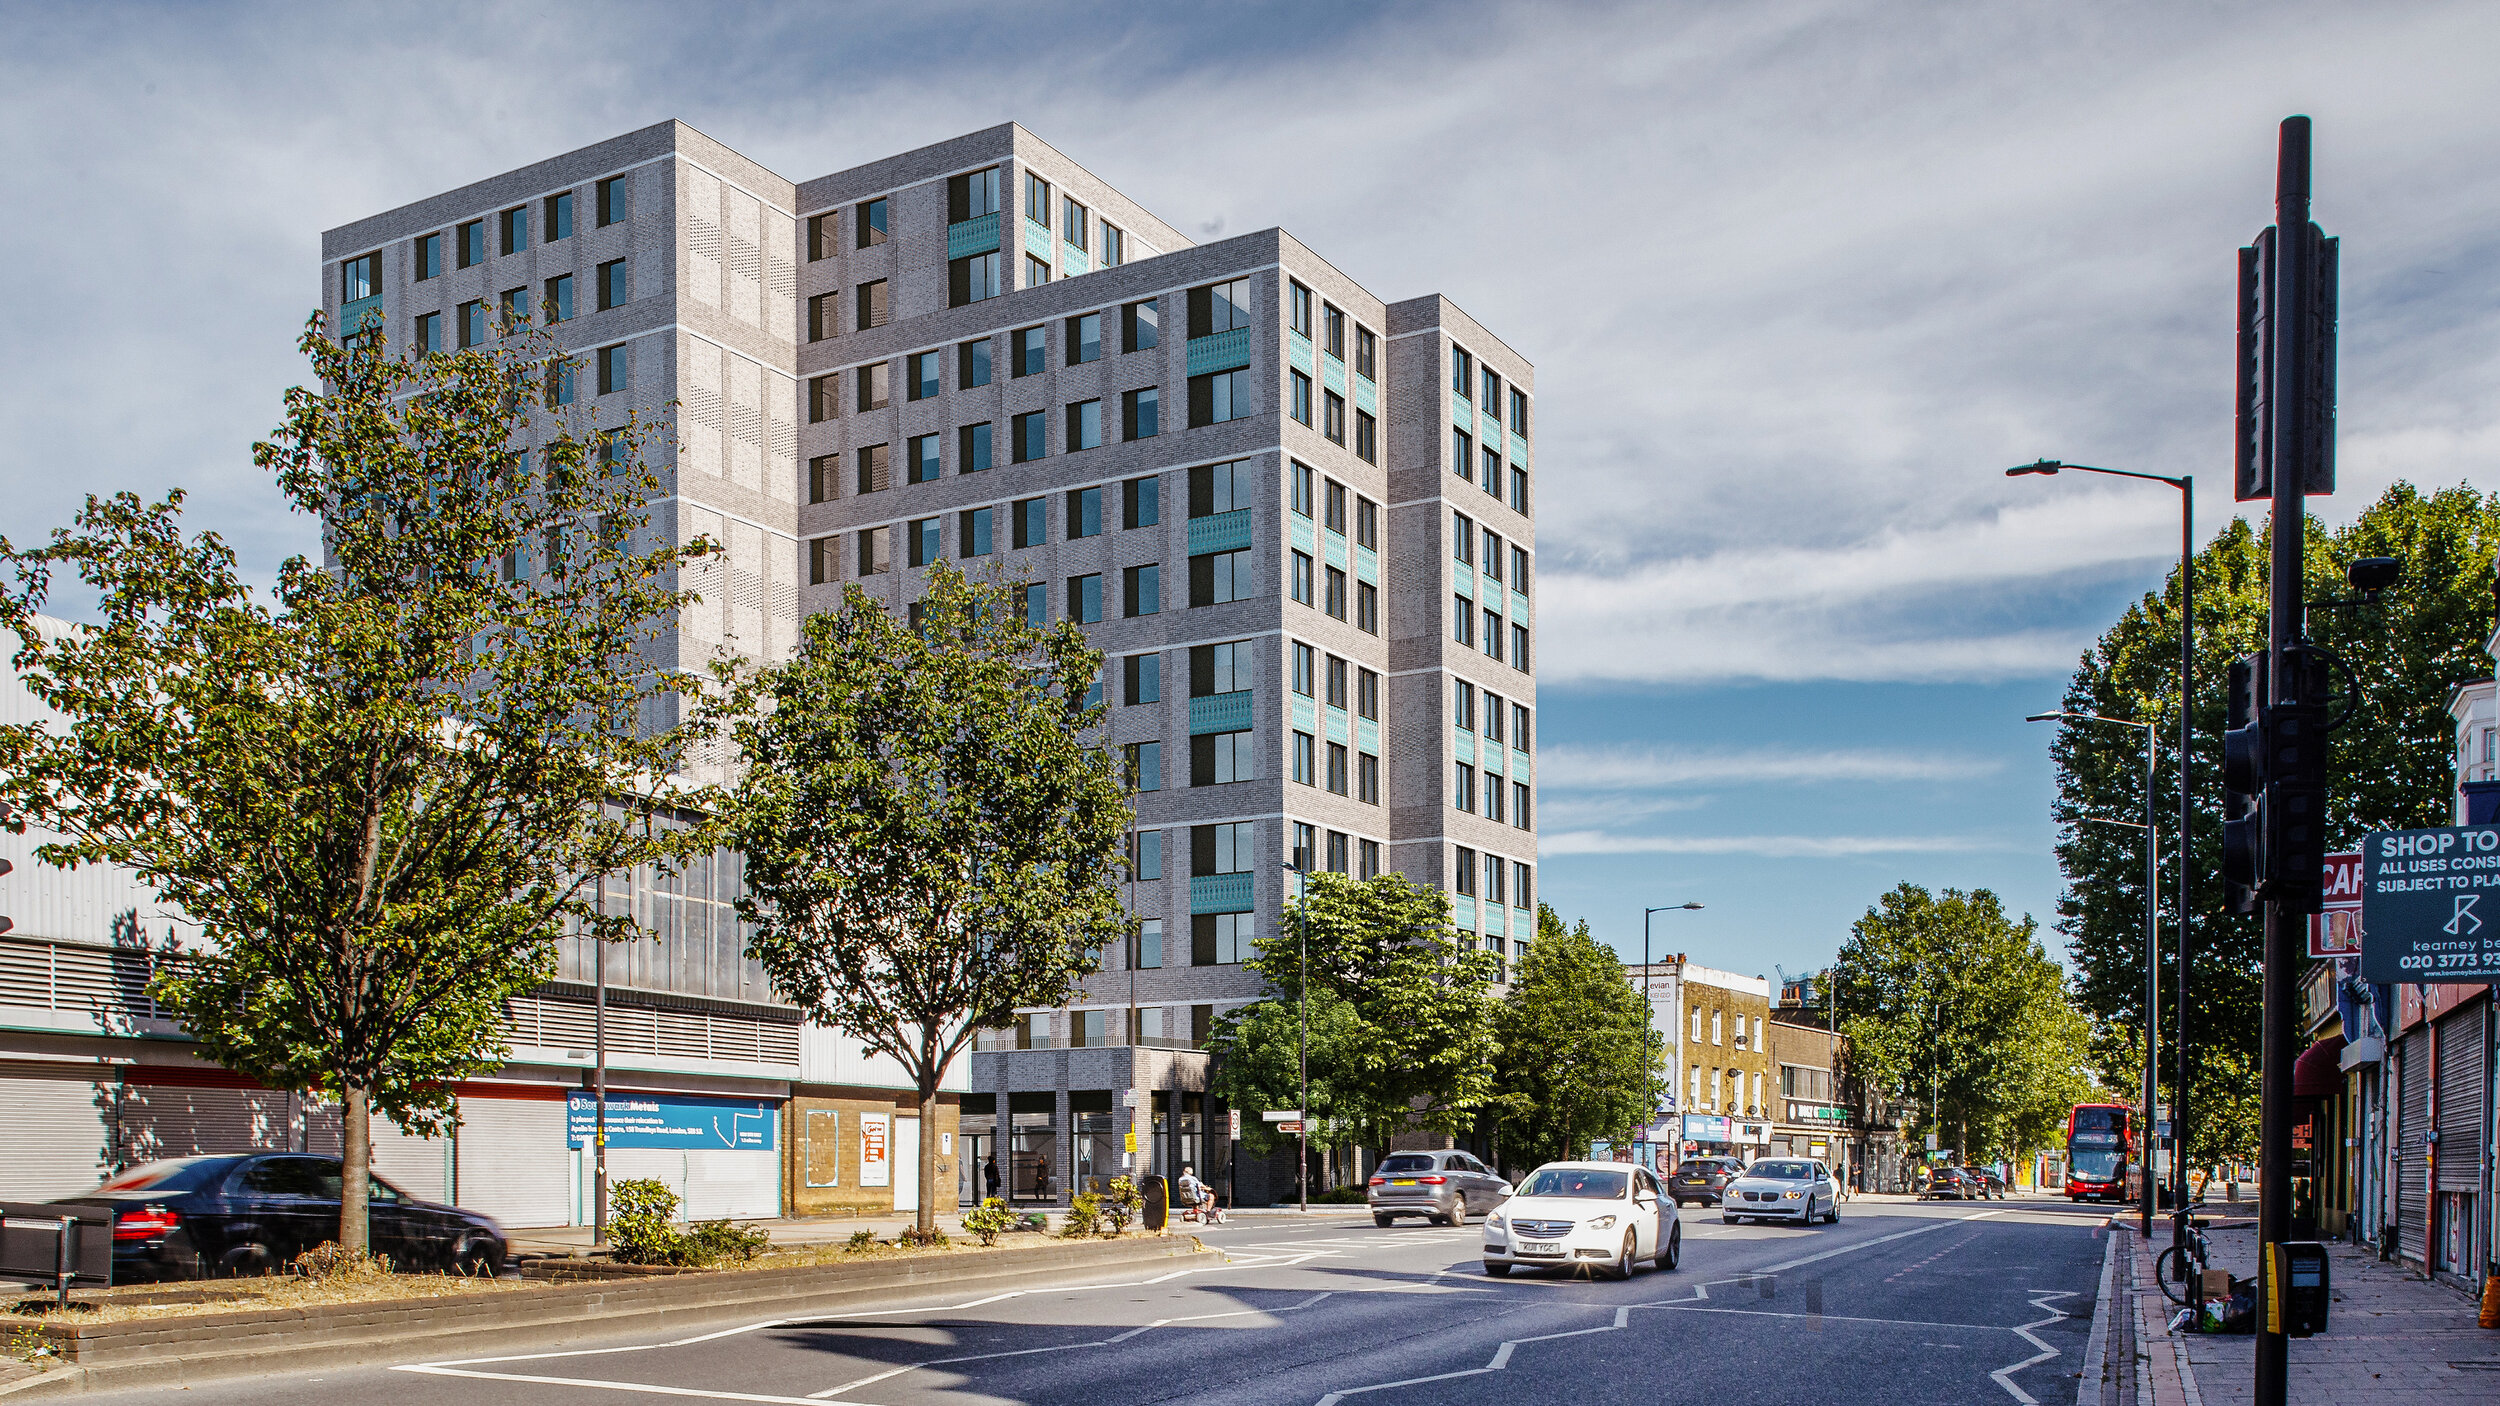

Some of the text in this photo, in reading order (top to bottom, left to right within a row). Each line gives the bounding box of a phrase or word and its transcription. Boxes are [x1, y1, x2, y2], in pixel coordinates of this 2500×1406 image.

[2381, 830, 2499, 858] SHOP TO
[2378, 861, 2406, 875] ALL
[2408, 858, 2447, 873] USES
[2377, 877, 2444, 893] SUBJECT
[2447, 876, 2469, 889] TO
[2413, 940, 2477, 952] kearney
[2400, 954, 2433, 969] 020
[2437, 953, 2478, 967] 3773
[1649, 981, 1670, 990] evian
